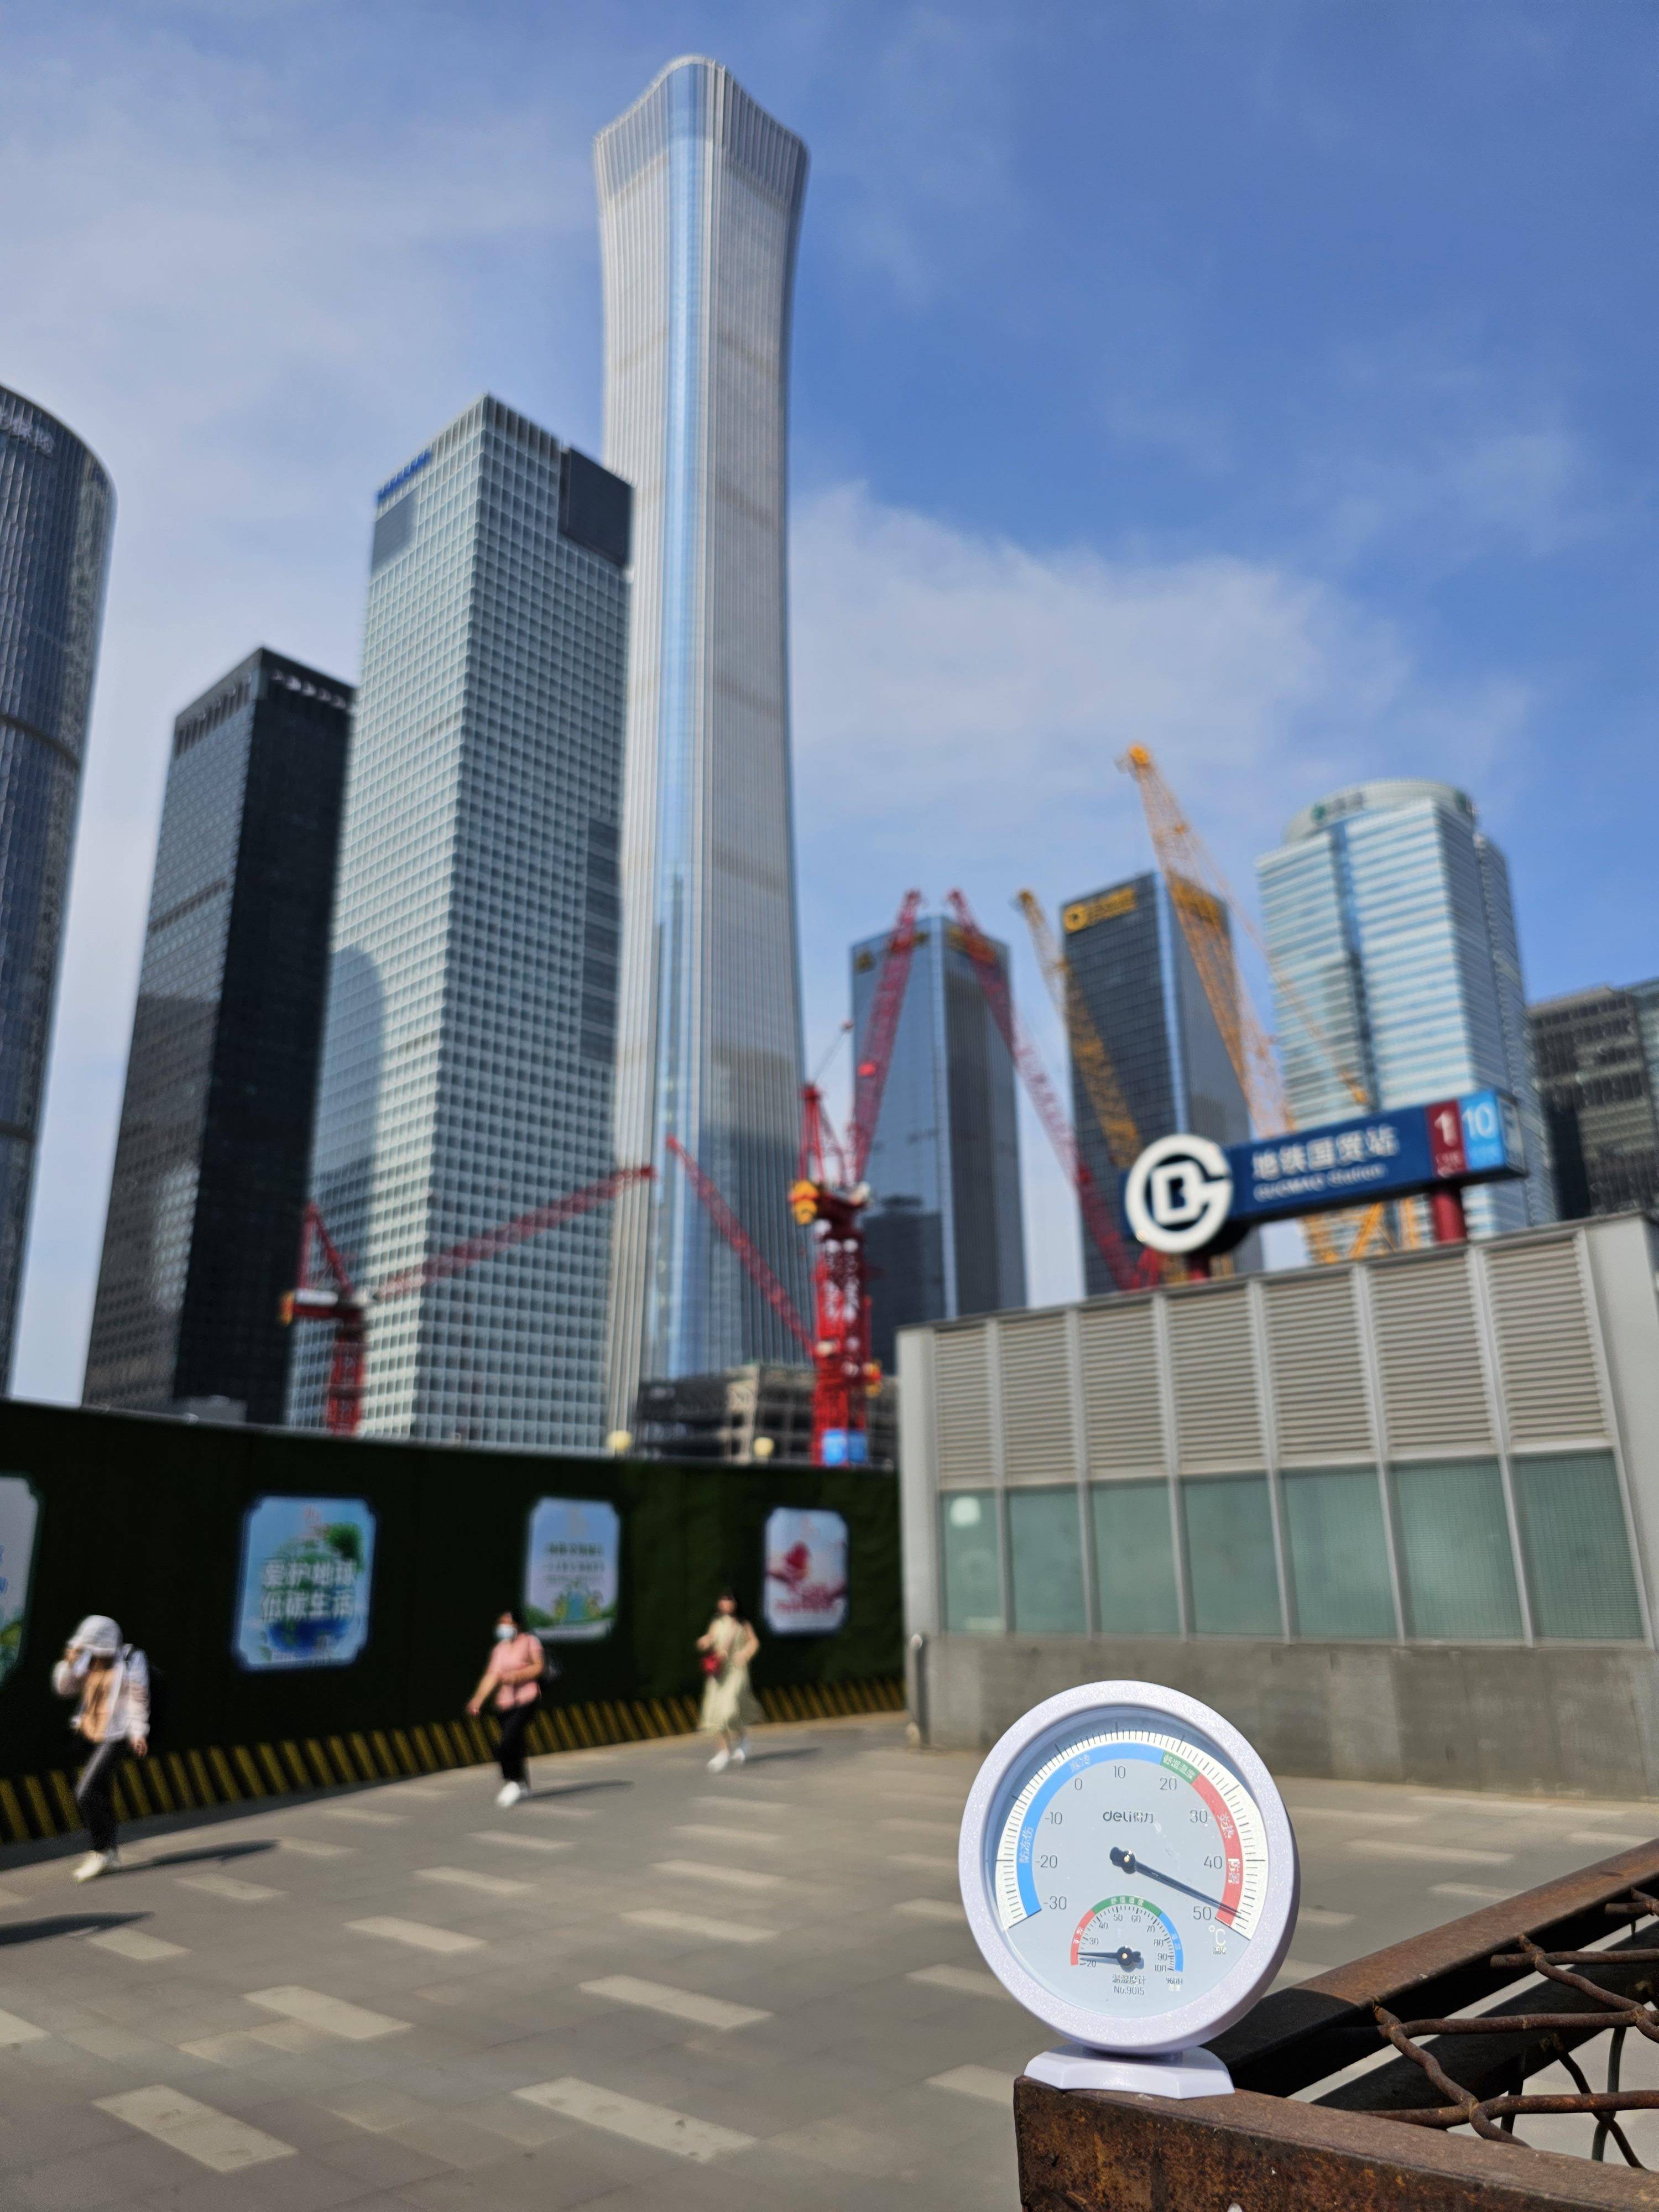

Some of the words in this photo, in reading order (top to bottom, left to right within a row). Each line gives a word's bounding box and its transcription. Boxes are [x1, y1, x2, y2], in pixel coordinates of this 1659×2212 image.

[1434, 1109, 1458, 1146] 1
[1462, 1101, 1498, 1140] 10
[1113, 1765, 1126, 1778] 10
[1074, 1777, 1083, 1791] 0
[1160, 1777, 1177, 1791] 20
[1044, 1811, 1062, 1825] -10
[1190, 1809, 1208, 1823] 30
[1035, 1854, 1057, 1869] -20
[1204, 1855, 1222, 1869] 40
[1044, 1895, 1067, 1910] -30
[1131, 1914, 1141, 1923] 60
[1193, 1906, 1211, 1921] 50
[1146, 1924, 1155, 1933] 70
[1089, 1937, 1099, 1945] 30
[1154, 1938, 1164, 1947] 80
[1157, 1953, 1167, 1961] 90
[1154, 1964, 1167, 1973] 100
[1114, 1985, 1145, 1996] No.9015
